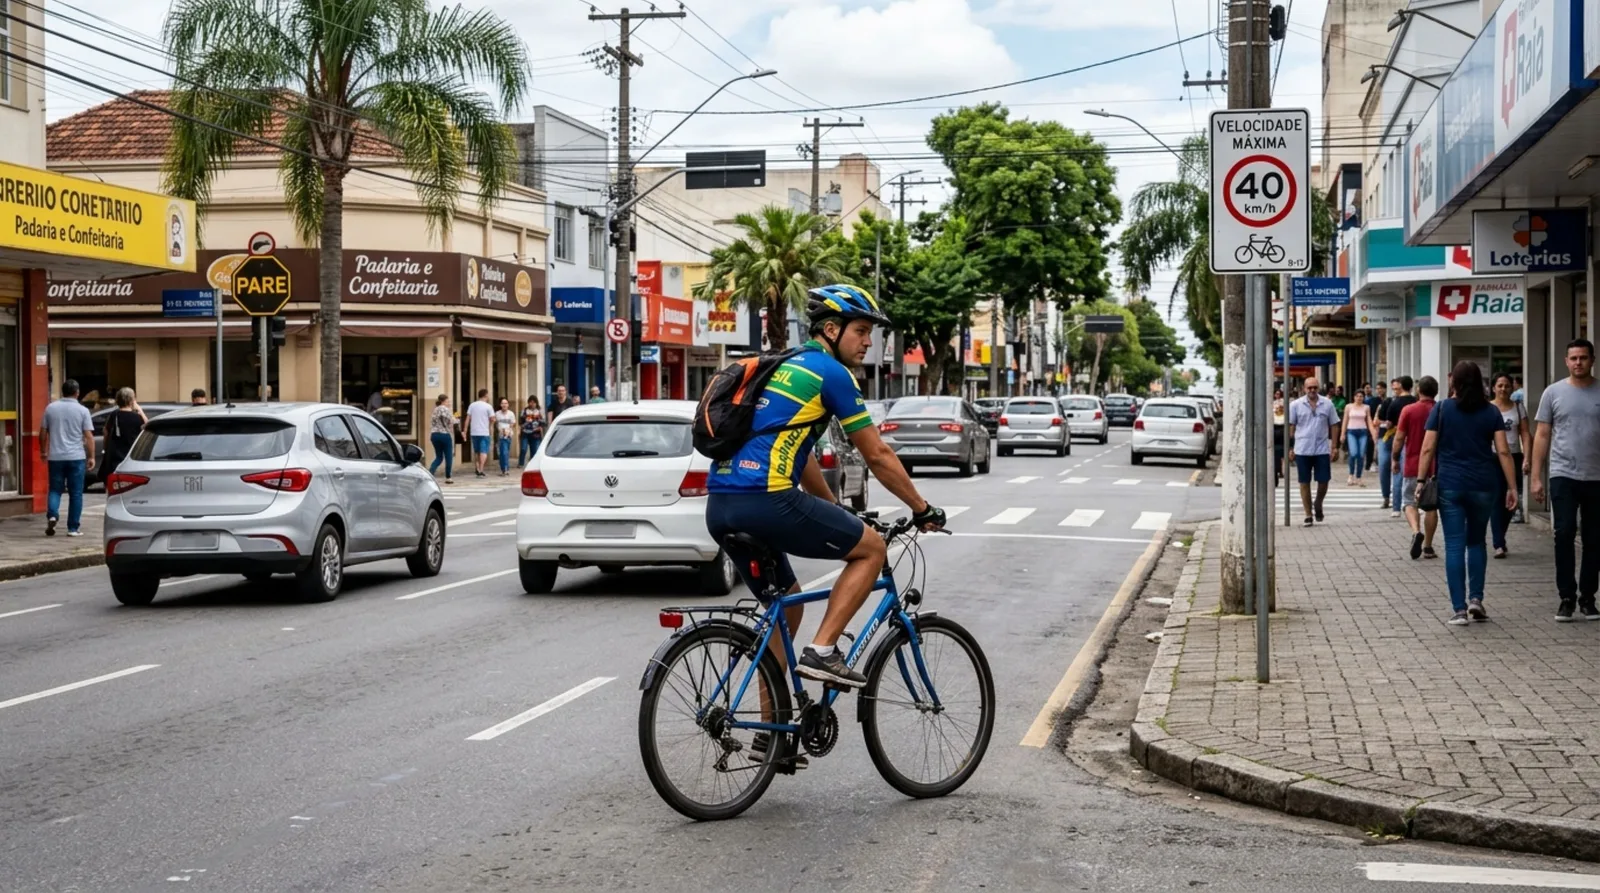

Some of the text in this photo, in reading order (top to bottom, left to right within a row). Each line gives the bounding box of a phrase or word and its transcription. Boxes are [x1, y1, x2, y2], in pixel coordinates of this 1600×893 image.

[1217, 119, 1302, 132] VELOCIDADE
[1232, 134, 1287, 150] MÁXIMA
[1235, 172, 1284, 200] 40
[1244, 203, 1276, 214] km/h
[15, 214, 124, 250] Padaria e Confeitaria
[355, 254, 433, 275] Padaria e
[1490, 249, 1571, 267] Loterias
[47, 279, 134, 301] onfeitaria
[237, 276, 287, 294] PARE
[349, 276, 439, 299] Confeitaria
[1471, 293, 1525, 314] Raia
